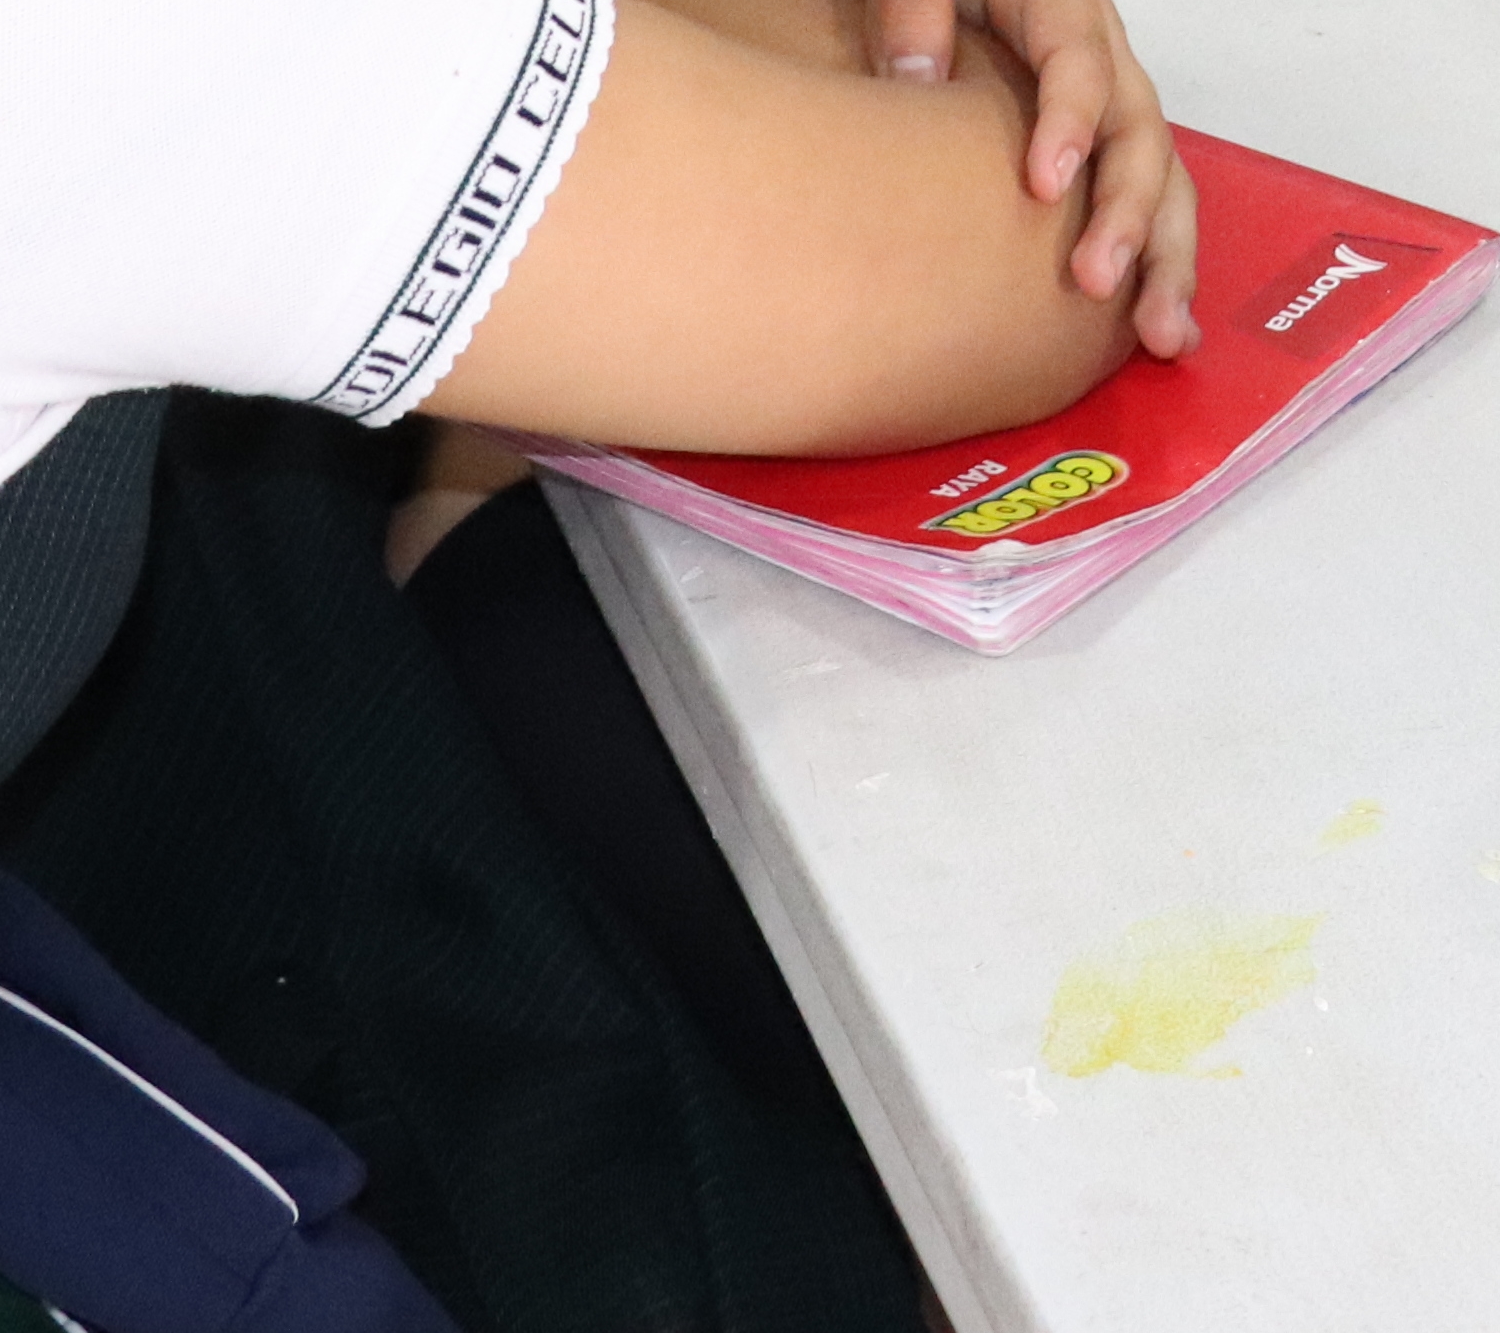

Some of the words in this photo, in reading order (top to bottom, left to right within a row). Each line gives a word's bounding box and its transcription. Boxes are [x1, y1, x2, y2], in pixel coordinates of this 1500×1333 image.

[1264, 242, 1389, 332] Norma
[928, 458, 1009, 498] RAYA
[942, 455, 1115, 533] COLOR
